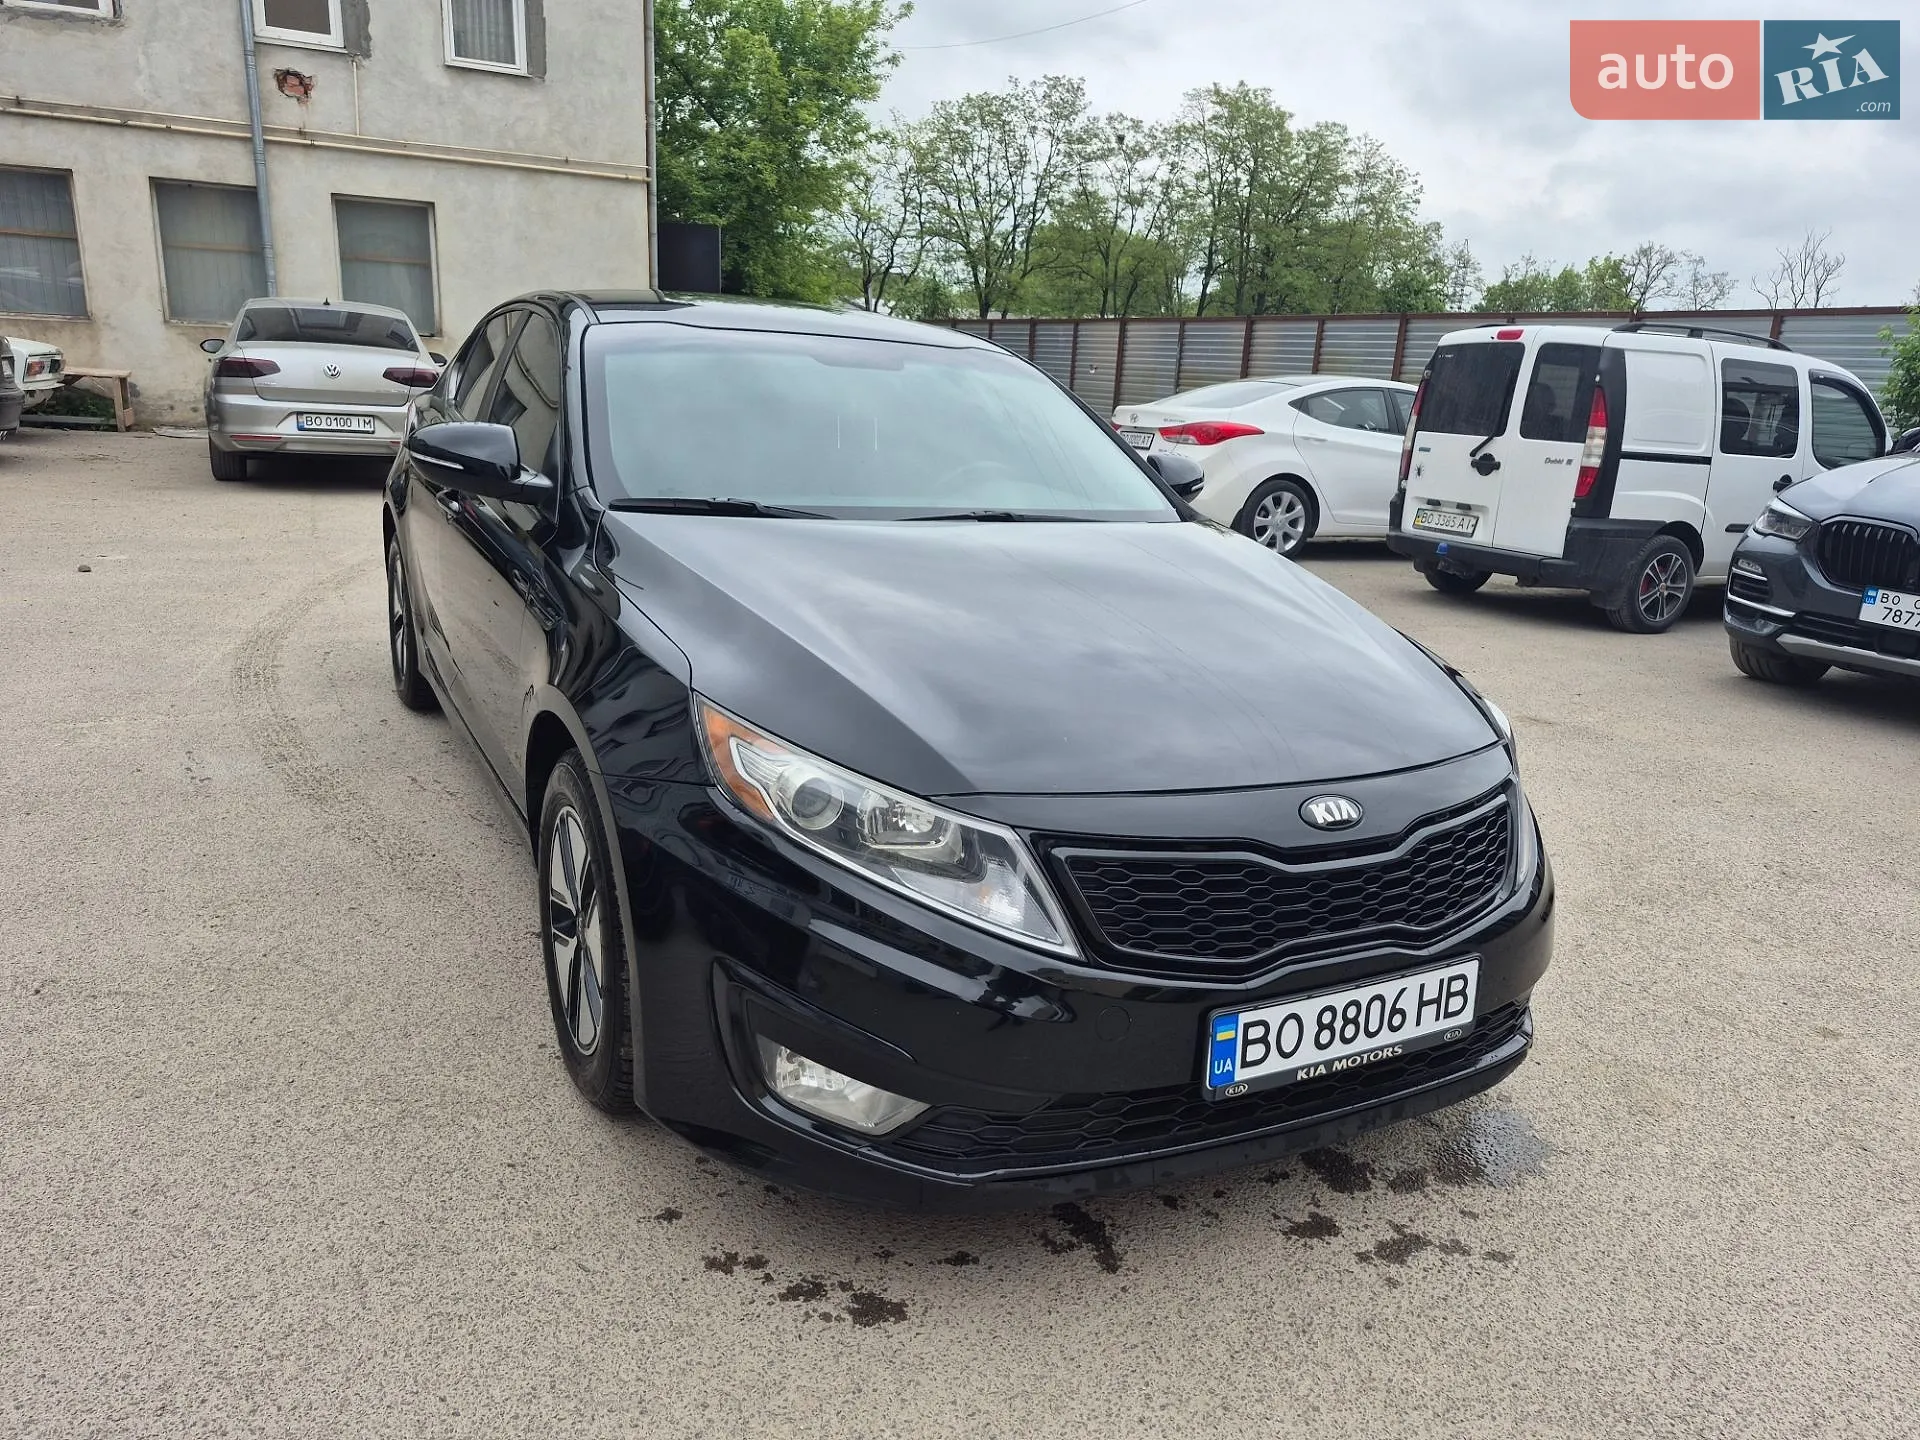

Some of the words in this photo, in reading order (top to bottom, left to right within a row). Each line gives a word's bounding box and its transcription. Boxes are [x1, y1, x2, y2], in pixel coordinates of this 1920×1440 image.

[305, 415, 322, 426] BO
[325, 416, 352, 428] 0100
[1881, 592, 1901, 605] BO
[1306, 799, 1358, 824] KIA
[1240, 1012, 1304, 1069] BO
[1314, 987, 1408, 1051] 8806
[1416, 973, 1469, 1027] HB
[1214, 1057, 1233, 1074] UA
[1297, 1064, 1326, 1080] KIA
[1332, 1045, 1403, 1071] MOTORS
